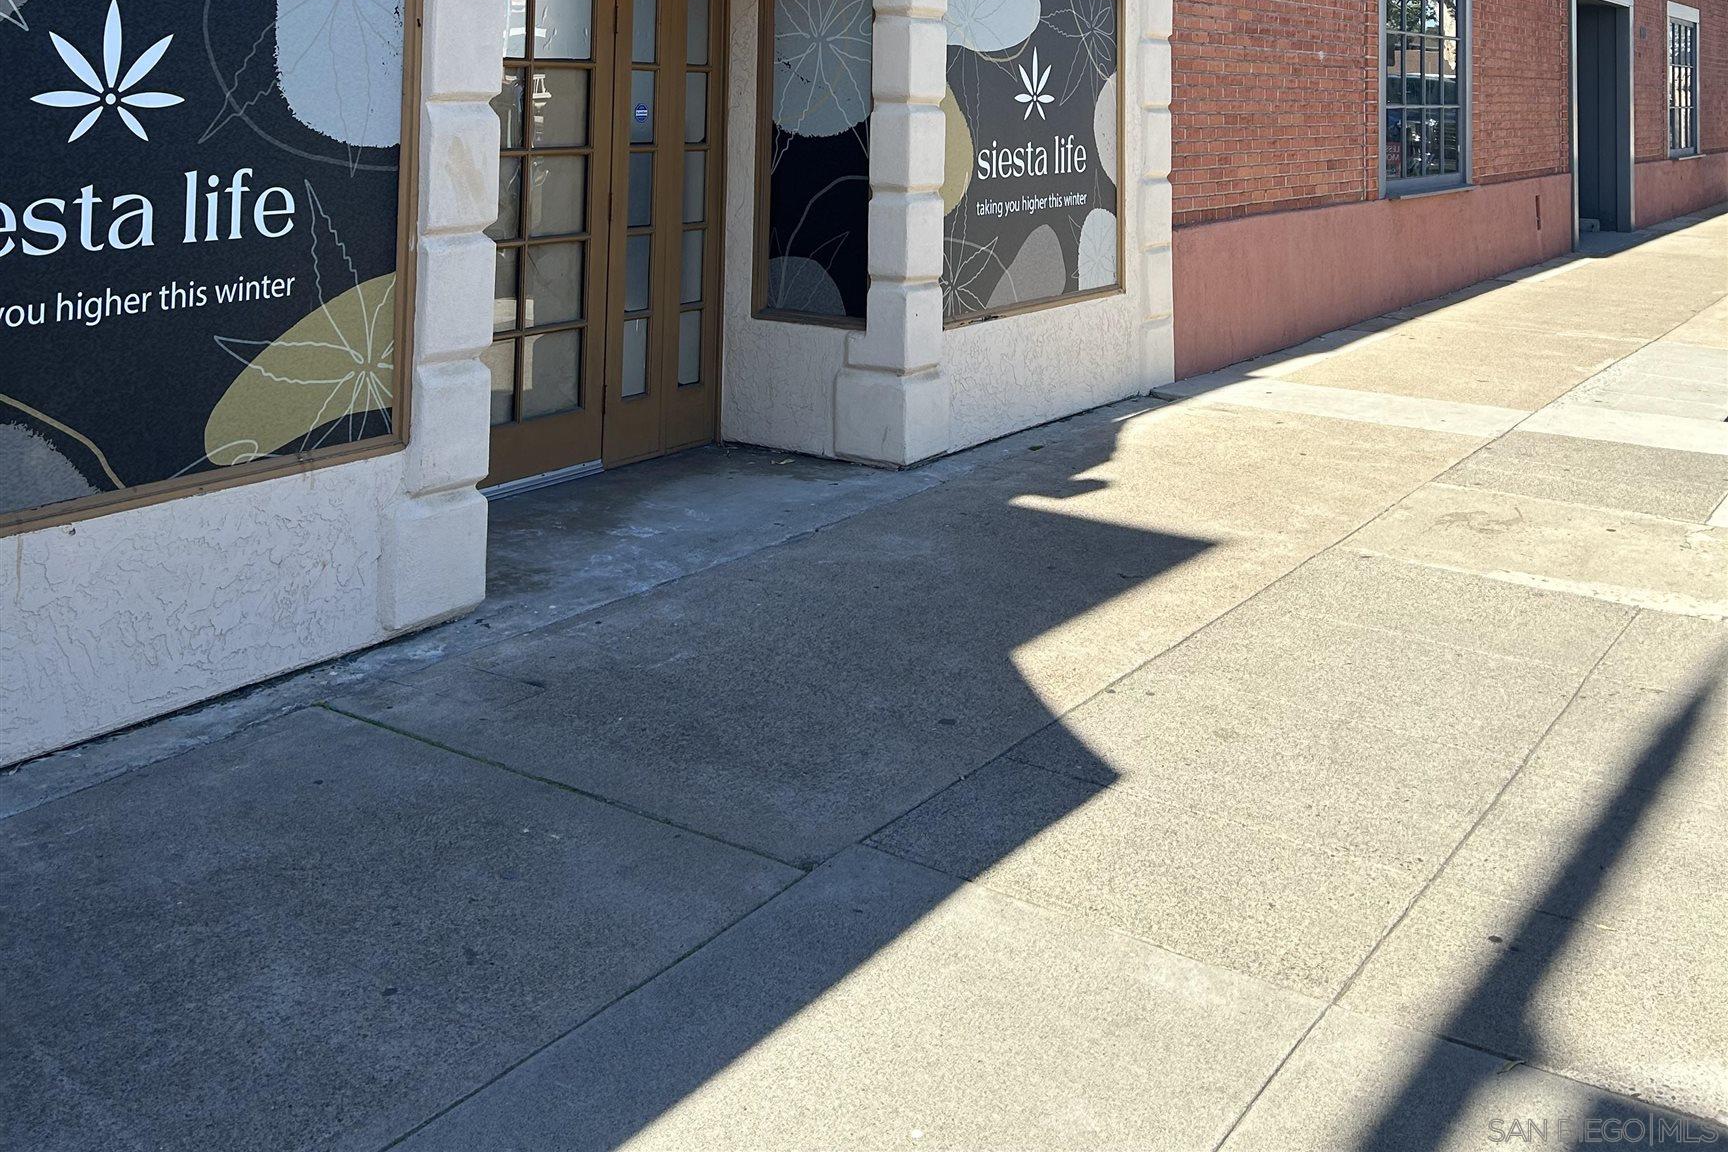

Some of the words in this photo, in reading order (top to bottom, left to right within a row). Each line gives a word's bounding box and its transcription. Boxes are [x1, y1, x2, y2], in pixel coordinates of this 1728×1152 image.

[977, 140, 1048, 180] siesta
[1054, 134, 1087, 174] life
[182, 167, 296, 244] life
[976, 198, 1003, 218] taking
[1004, 200, 1020, 217] you
[1021, 194, 1048, 215] higher
[1048, 192, 1063, 209] this
[1063, 192, 1088, 208] winter
[55, 287, 153, 327] higher
[159, 280, 208, 311] this
[215, 275, 297, 304] winter
